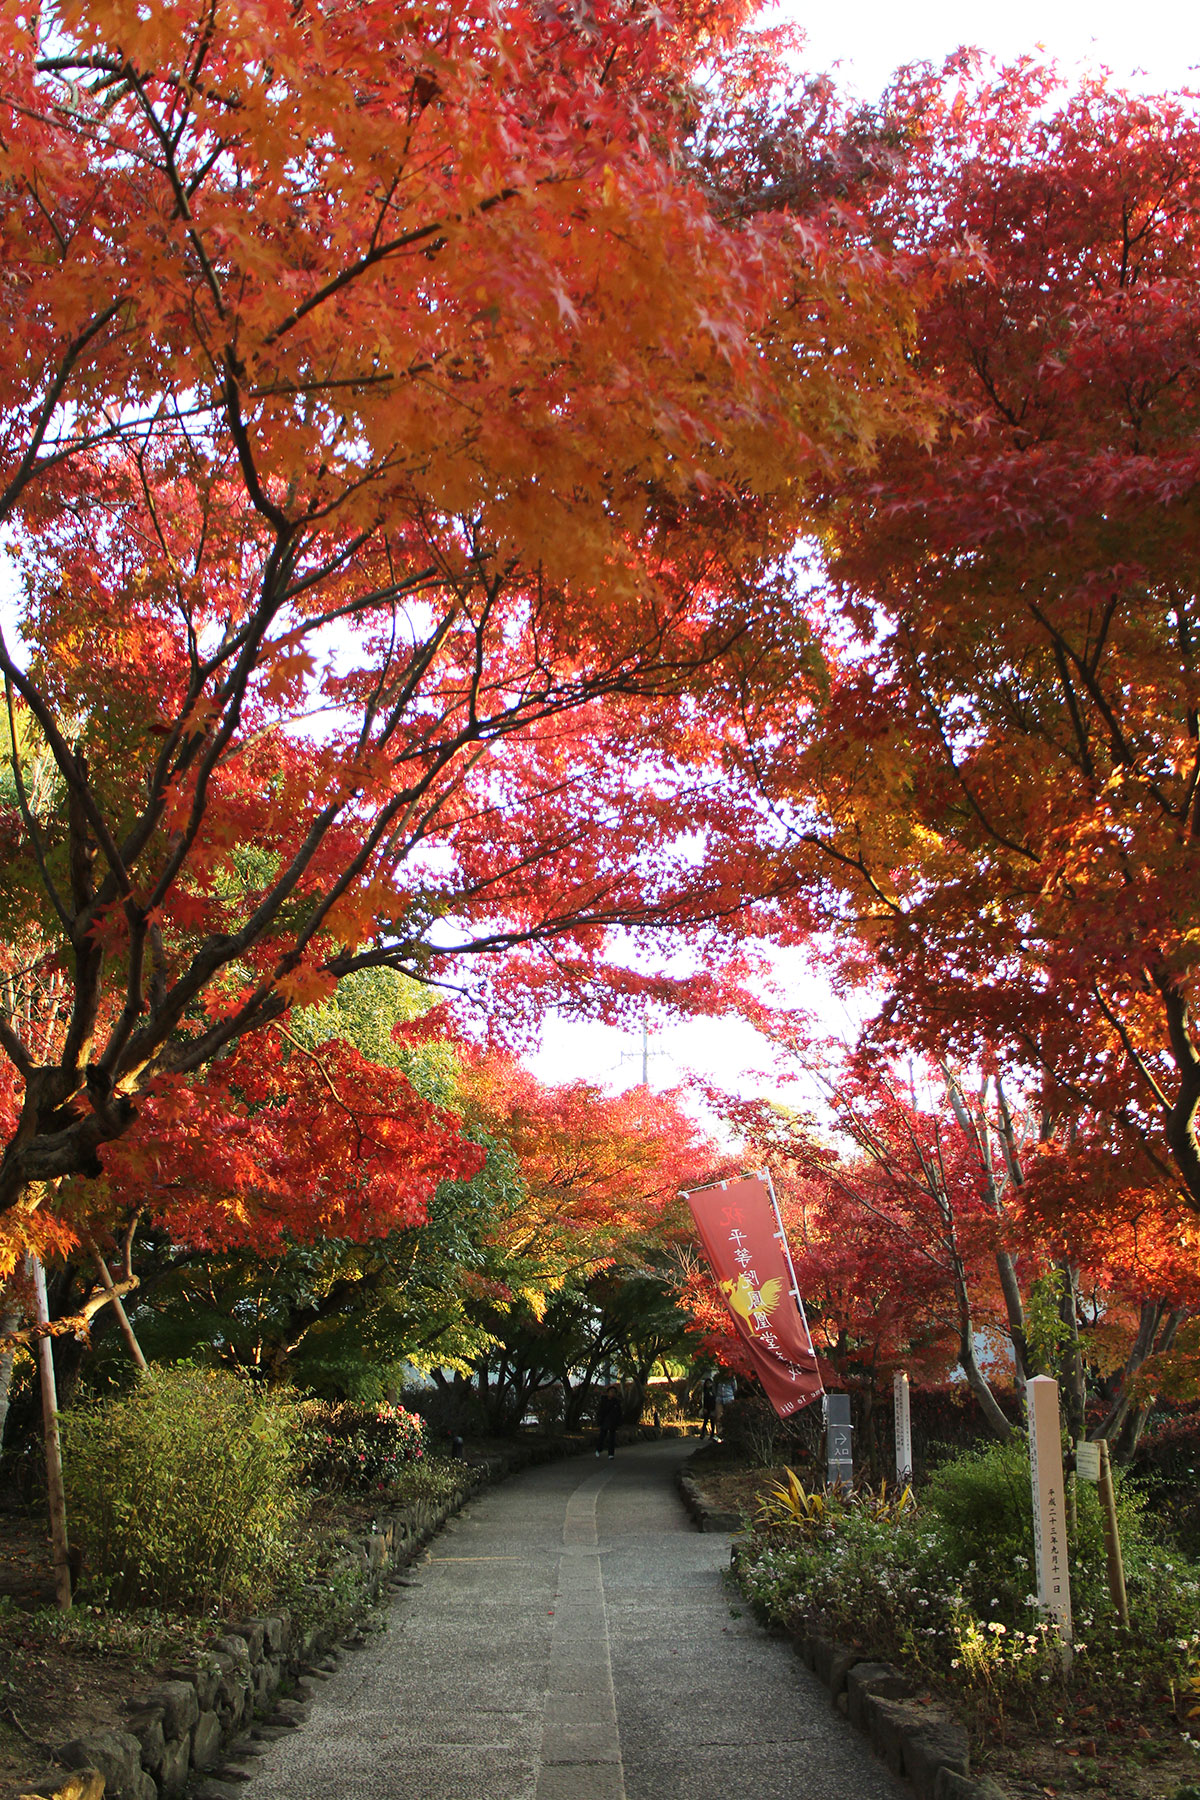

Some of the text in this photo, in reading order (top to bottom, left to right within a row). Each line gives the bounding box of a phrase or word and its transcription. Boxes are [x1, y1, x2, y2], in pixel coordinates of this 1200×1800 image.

[1047, 1488, 1061, 1594] 平成二十三年九月十一日
